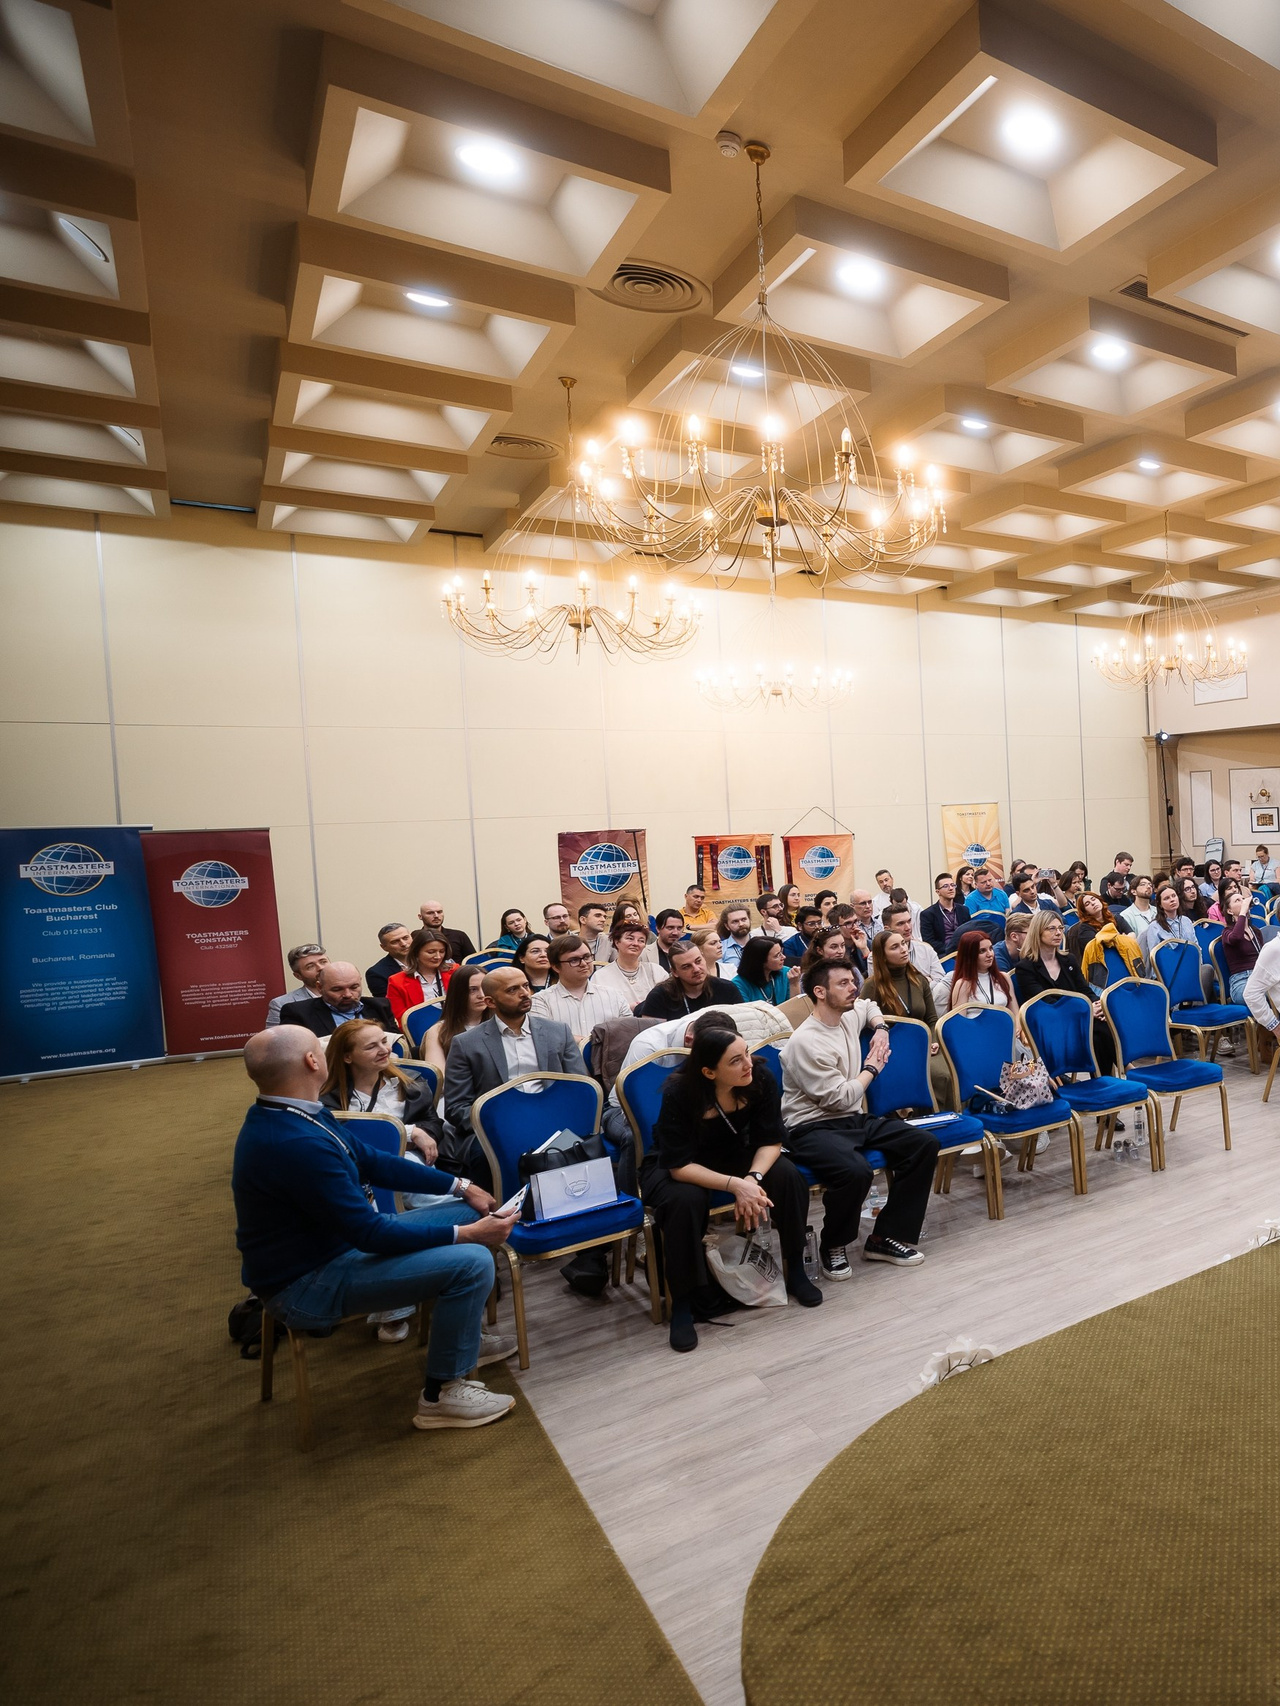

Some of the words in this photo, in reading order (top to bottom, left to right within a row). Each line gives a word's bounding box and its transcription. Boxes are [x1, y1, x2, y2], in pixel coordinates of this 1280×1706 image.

[23, 863, 111, 872] TOASTMASTERS
[572, 861, 637, 872] TOASTMASTERS
[580, 868, 630, 876] INTERNATIONAL
[23, 905, 92, 915] Toastmasters
[46, 913, 98, 922] Bucharest
[63, 927, 103, 935] 01216331
[186, 930, 249, 938] TOASTMASTERS
[79, 952, 115, 960] Romania
[41, 1047, 116, 1060] www.toastmasters.org
